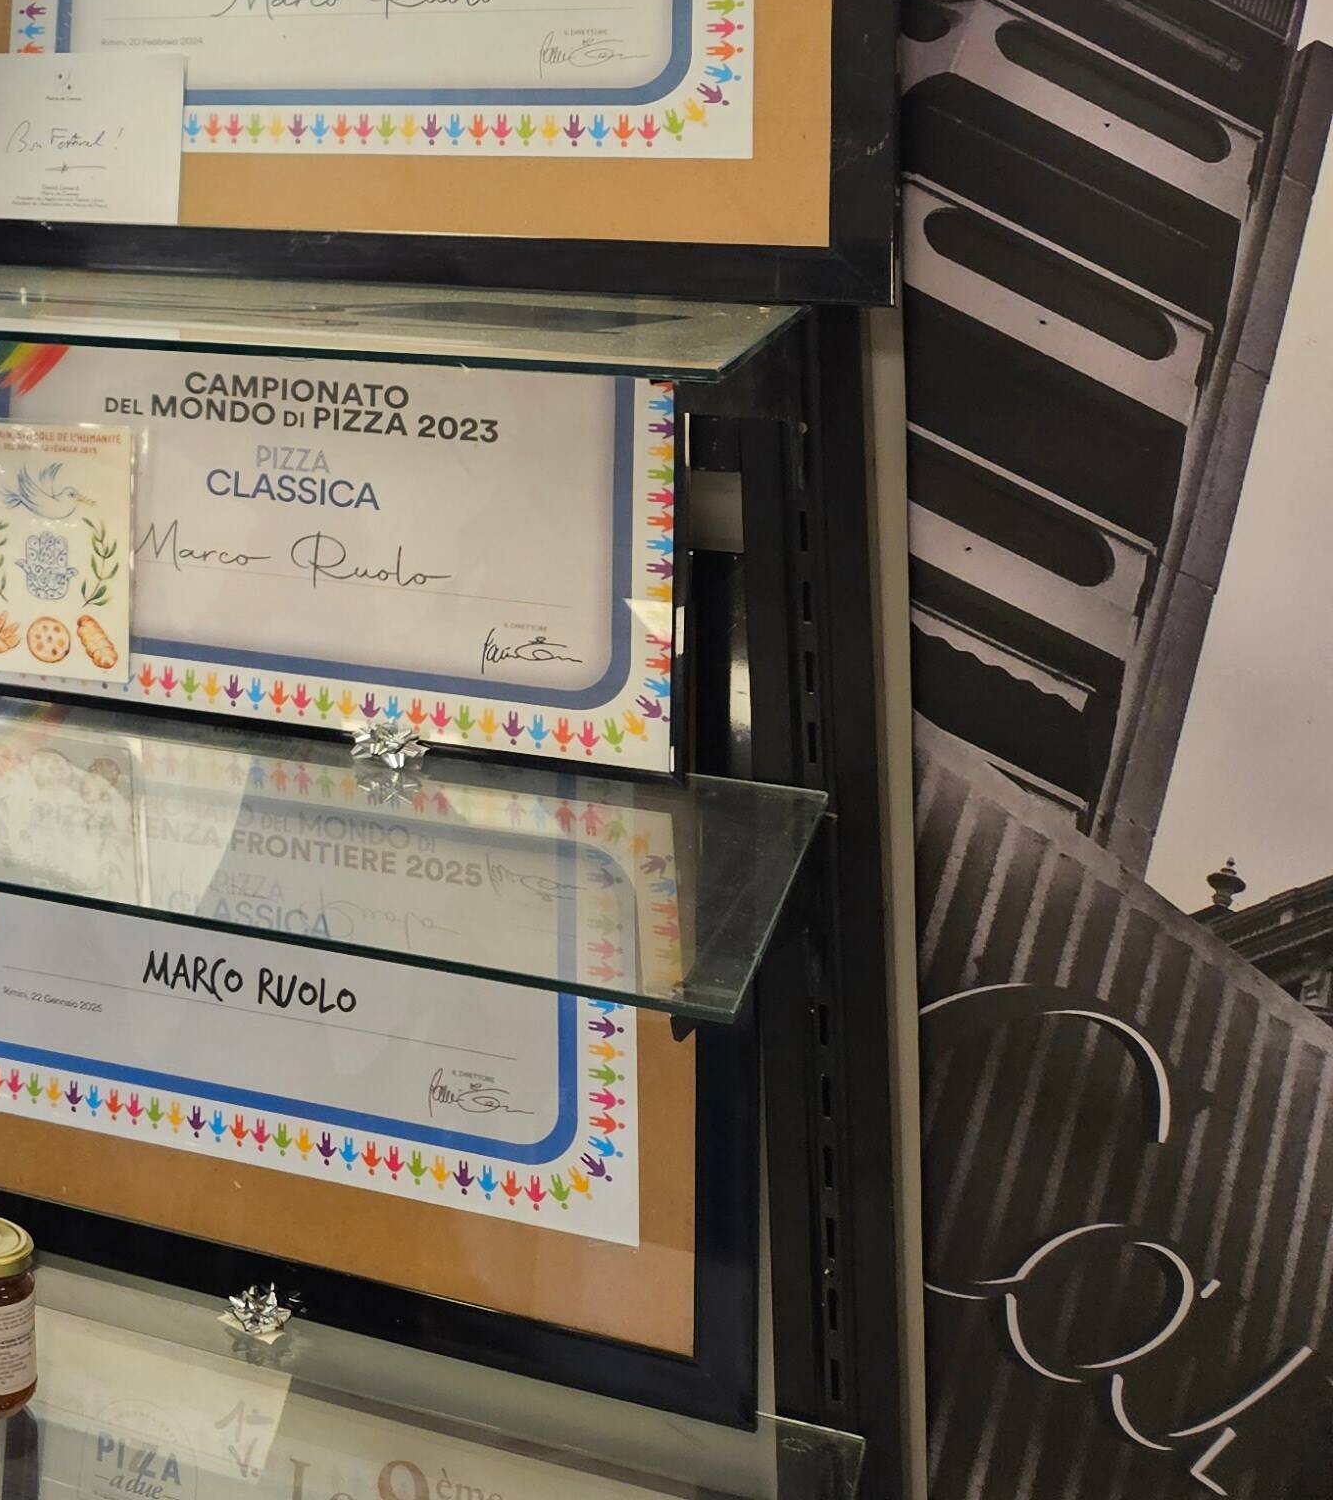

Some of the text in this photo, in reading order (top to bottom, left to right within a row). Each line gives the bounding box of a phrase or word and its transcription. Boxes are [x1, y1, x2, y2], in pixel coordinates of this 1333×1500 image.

[185, 370, 410, 410] CAMPIONATO
[105, 393, 500, 444] DEL MONDO DI PIZZA 2023
[255, 444, 331, 474] PIZZA
[206, 468, 380, 511] CLASSICA
[135, 519, 452, 589] Marco Ruolo
[145, 817, 222, 848] ENZA
[232, 829, 397, 875] FRONTIERE
[406, 853, 484, 888] 2025
[261, 813, 294, 832] DEL
[298, 813, 411, 850] MONDO
[168, 890, 332, 938] CASSICA
[142, 949, 357, 1014] MARCO RUOLO
[96, 1433, 183, 1487] PIZZA
